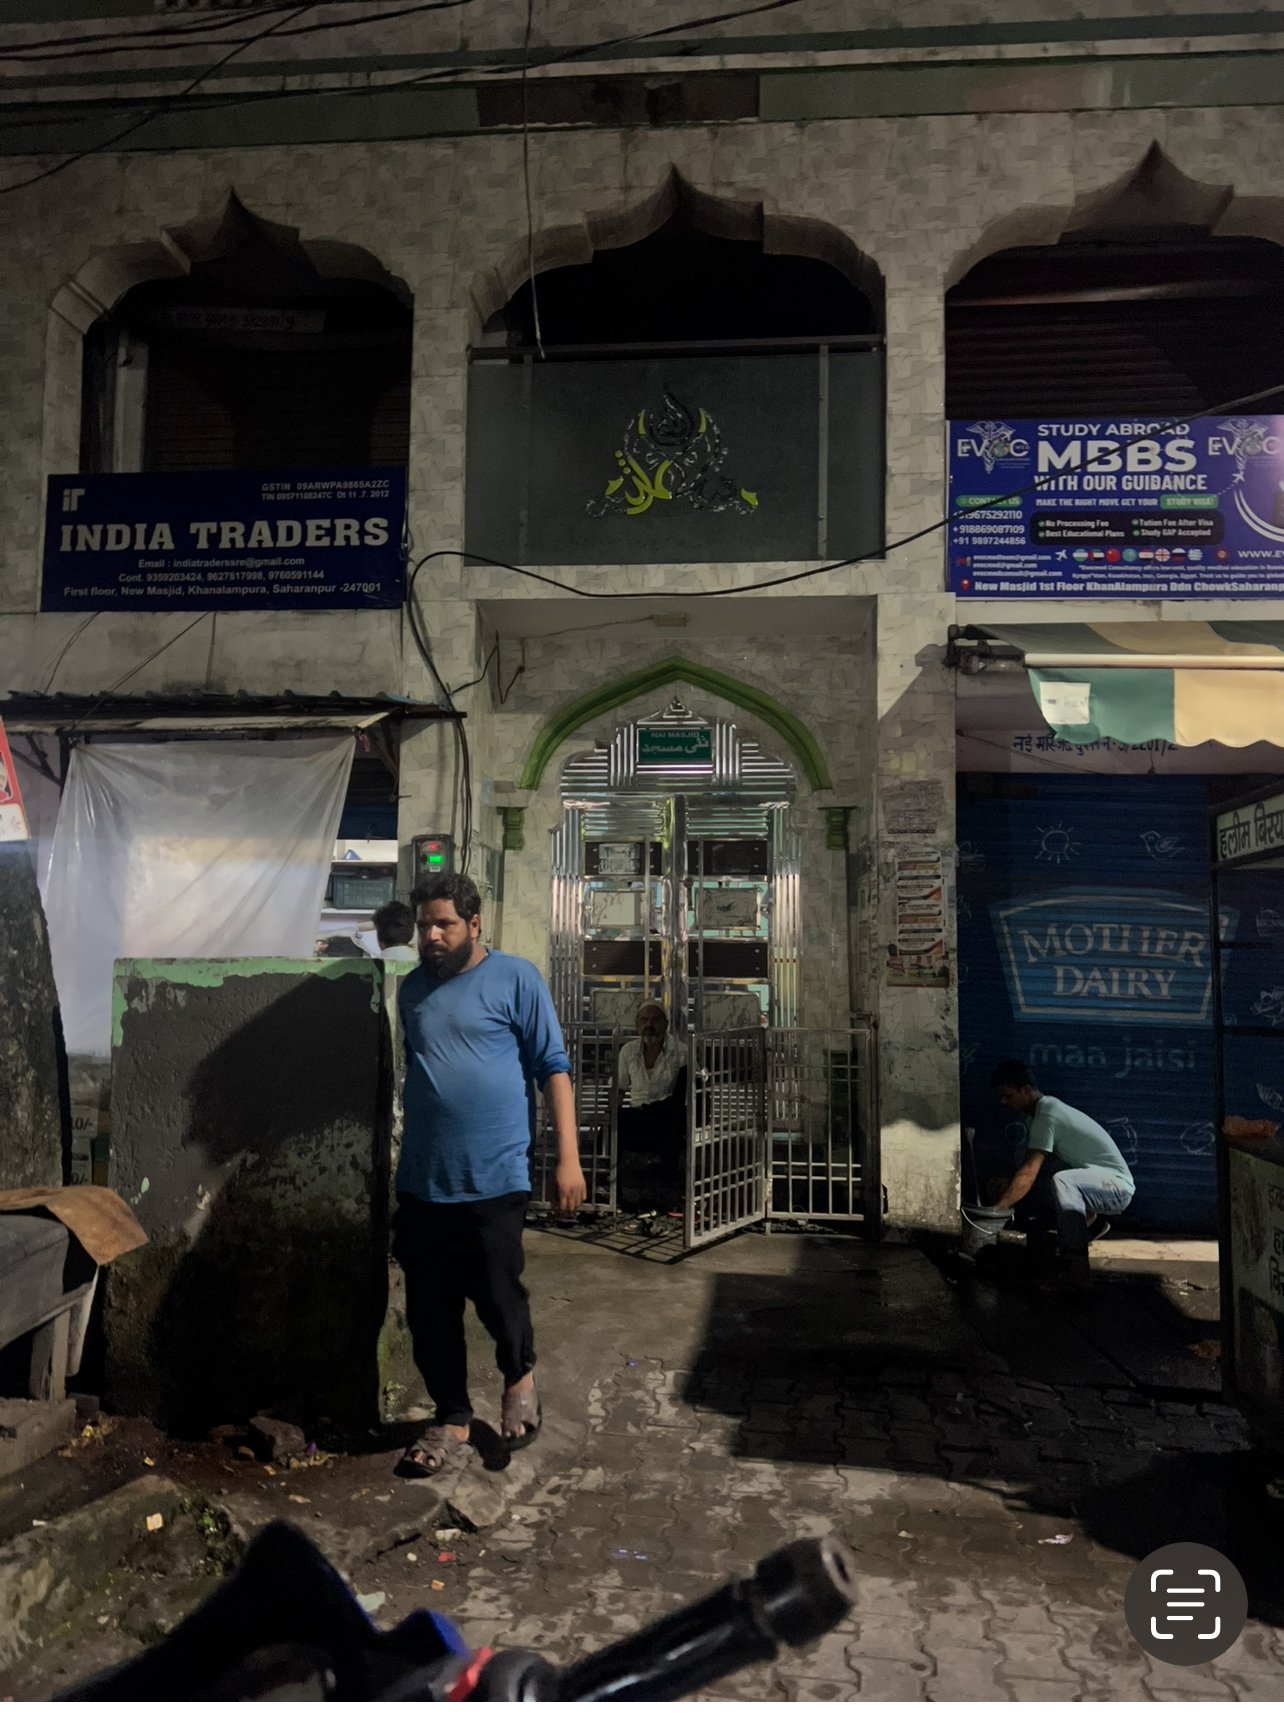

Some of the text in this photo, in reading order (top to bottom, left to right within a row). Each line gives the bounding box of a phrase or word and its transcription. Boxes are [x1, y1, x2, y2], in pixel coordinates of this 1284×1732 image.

[1038, 423, 1190, 437] STUDY ABROAD
[1037, 439, 1198, 473] MBBS
[261, 482, 291, 491] GSTIN
[1033, 474, 1207, 491] WITH OUR GUIDANCE
[261, 493, 275, 501] TIN
[968, 497, 1020, 505] CONT US
[1035, 498, 1057, 506] MAKE
[1058, 498, 1073, 506] THE
[1074, 498, 1097, 506] RIGHT
[1098, 498, 1120, 506] MOVE
[1121, 498, 1136, 506] GET
[1138, 498, 1158, 506] YOUR
[1056, 520, 1095, 529] Processing
[1163, 518, 1176, 526] Fee
[60, 517, 389, 552] INDIA TRADERS
[1062, 530, 1104, 538] Educational
[1178, 529, 1211, 537] Accepted
[953, 536, 969, 545] +91
[138, 559, 165, 568] Email
[118, 573, 144, 583] Cont.
[63, 586, 88, 597] First
[90, 586, 118, 598] floor,
[121, 586, 144, 596] New
[147, 585, 185, 598] Masjid,
[272, 583, 336, 595] Saharanpur
[974, 581, 998, 591] New
[999, 581, 1037, 592] Masjid
[1039, 581, 1055, 591] 1st
[1056, 581, 1084, 591] Floor
[1219, 810, 1251, 858] हलीम
[1018, 923, 1207, 968] MOTHER
[1053, 964, 1177, 999] DAIRY
[1029, 1036, 1197, 1079] maa jaisi
